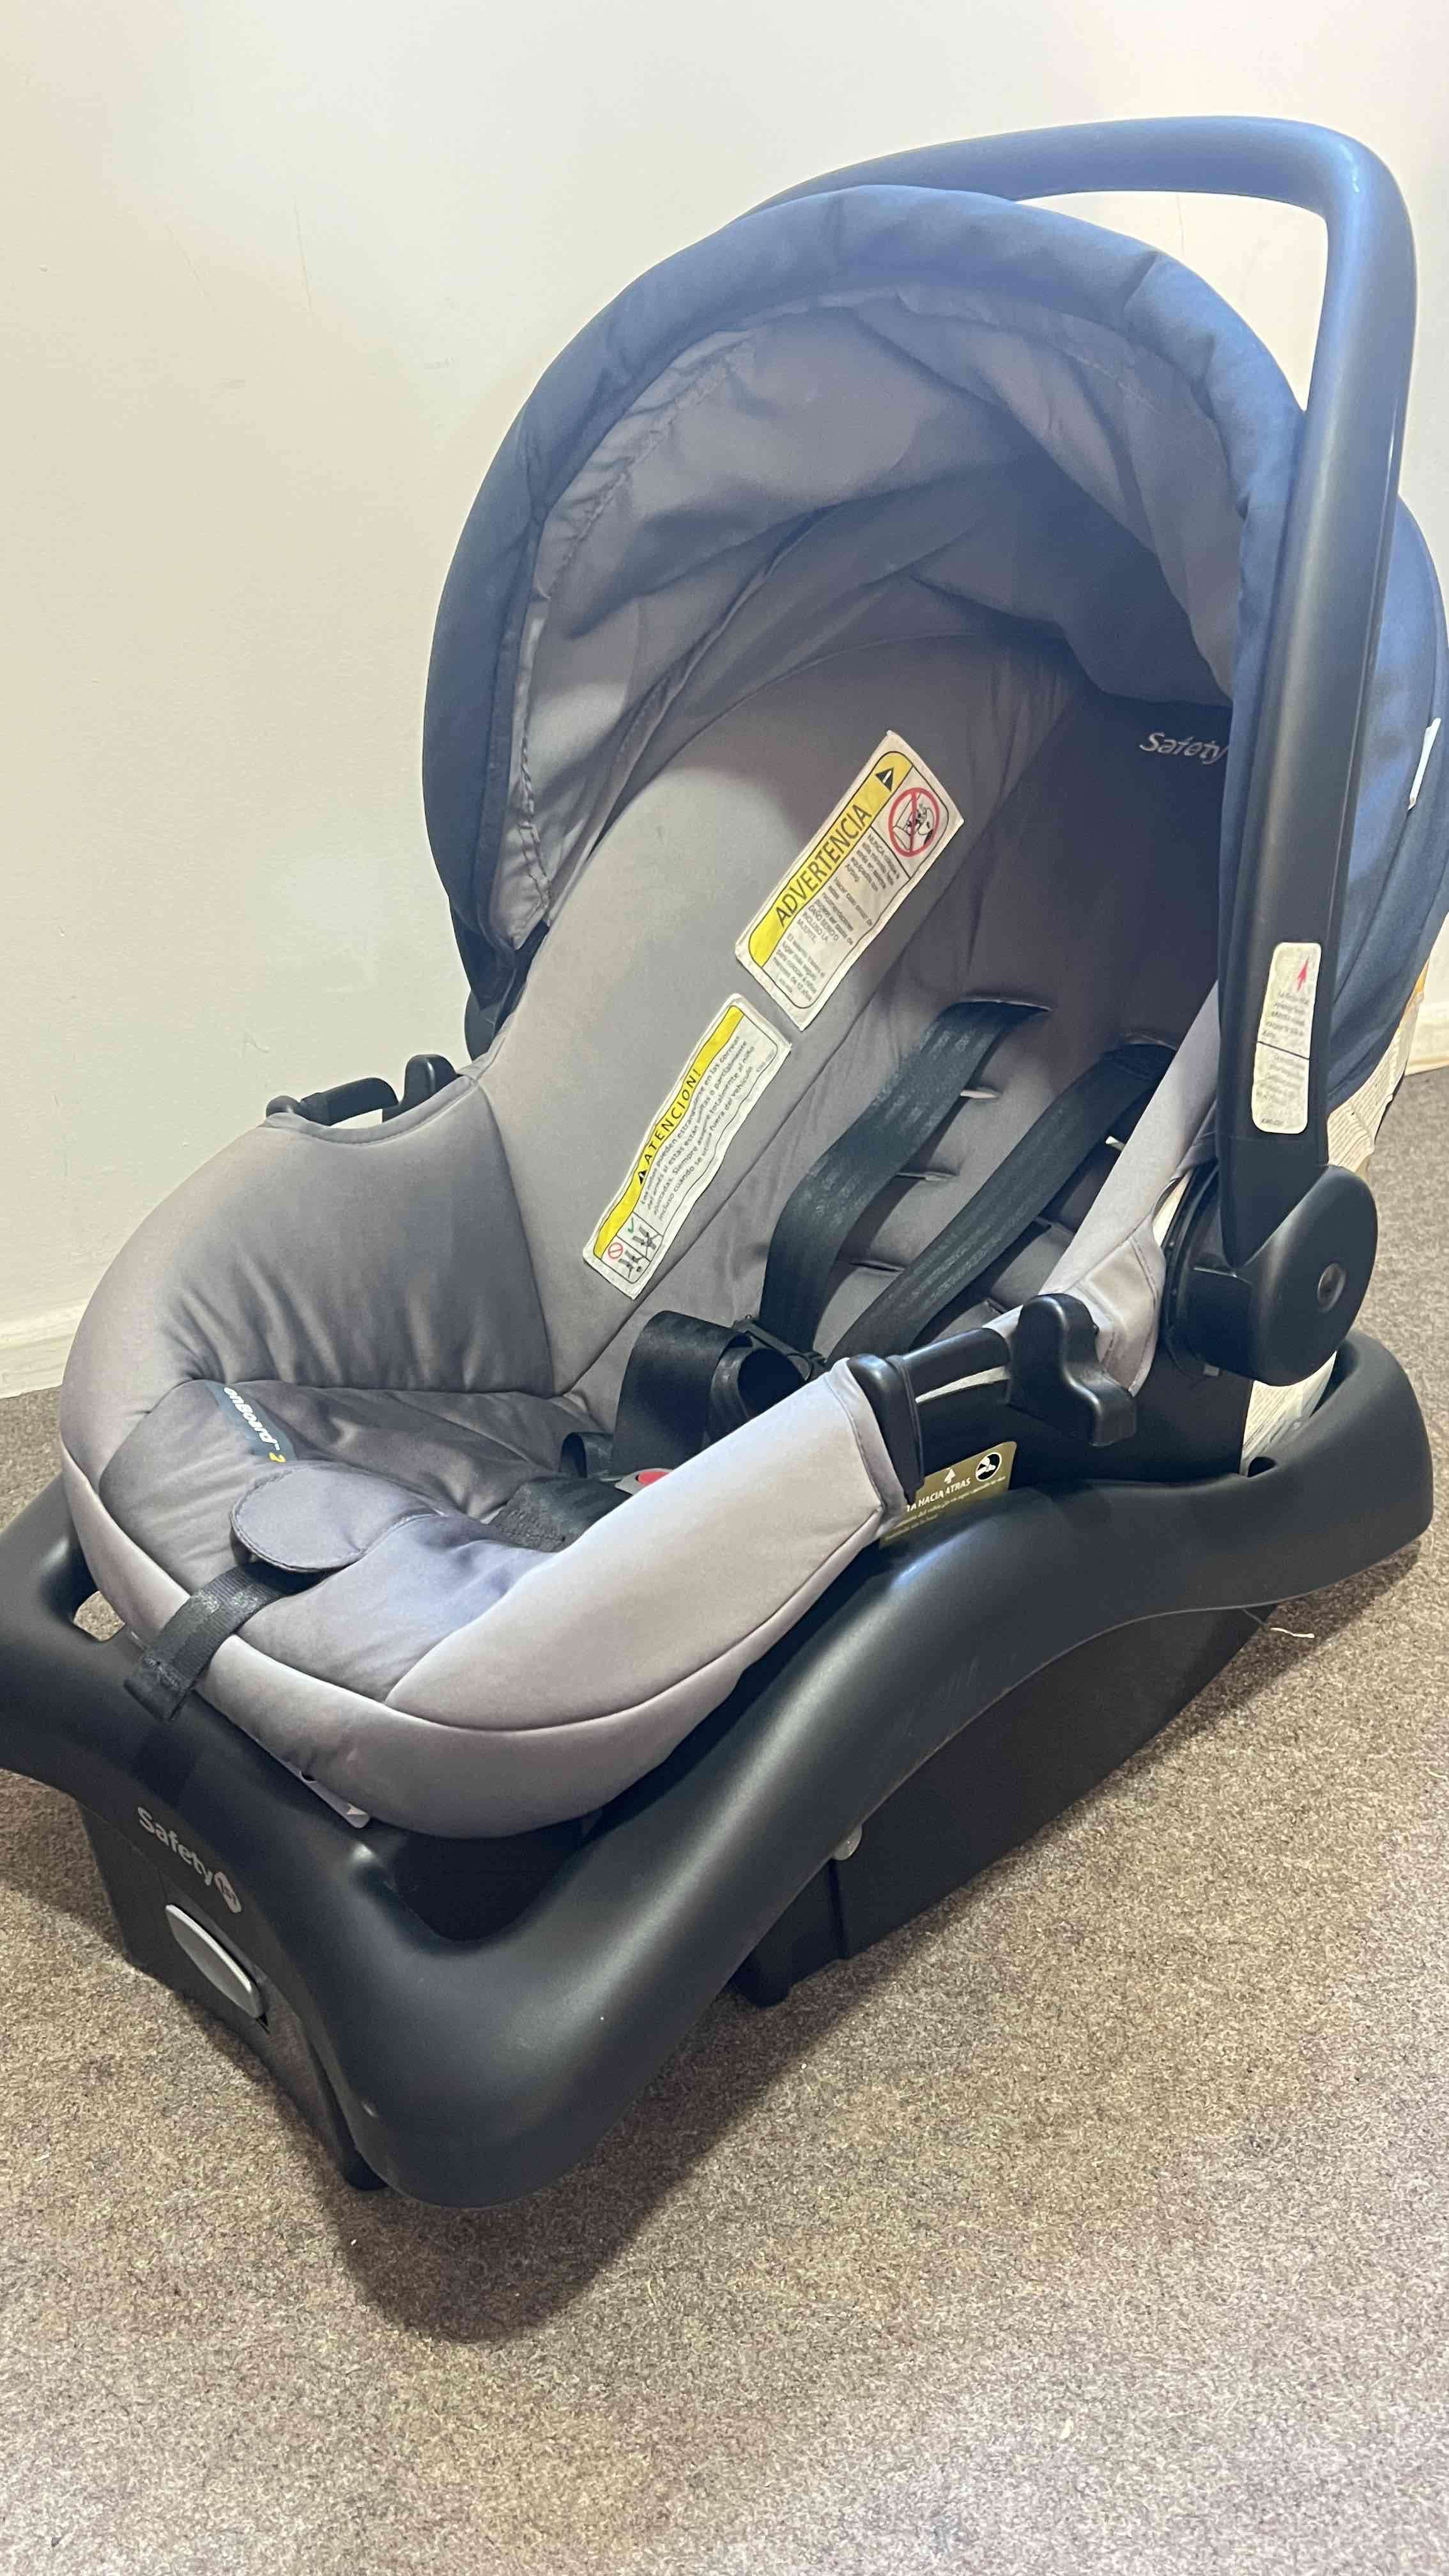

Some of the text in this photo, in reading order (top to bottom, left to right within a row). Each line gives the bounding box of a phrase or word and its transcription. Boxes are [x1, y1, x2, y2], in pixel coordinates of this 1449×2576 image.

[1139, 732, 1229, 765] Safety
[778, 804, 871, 926] ADVERTENCIA
[644, 1069, 701, 1165] ATENCION!
[655, 1138, 677, 1167] pueden
[709, 1063, 719, 1074] las
[673, 1165, 694, 1192] cuando
[709, 1111, 724, 1131] fuera
[137, 1806, 213, 1886] Safety
